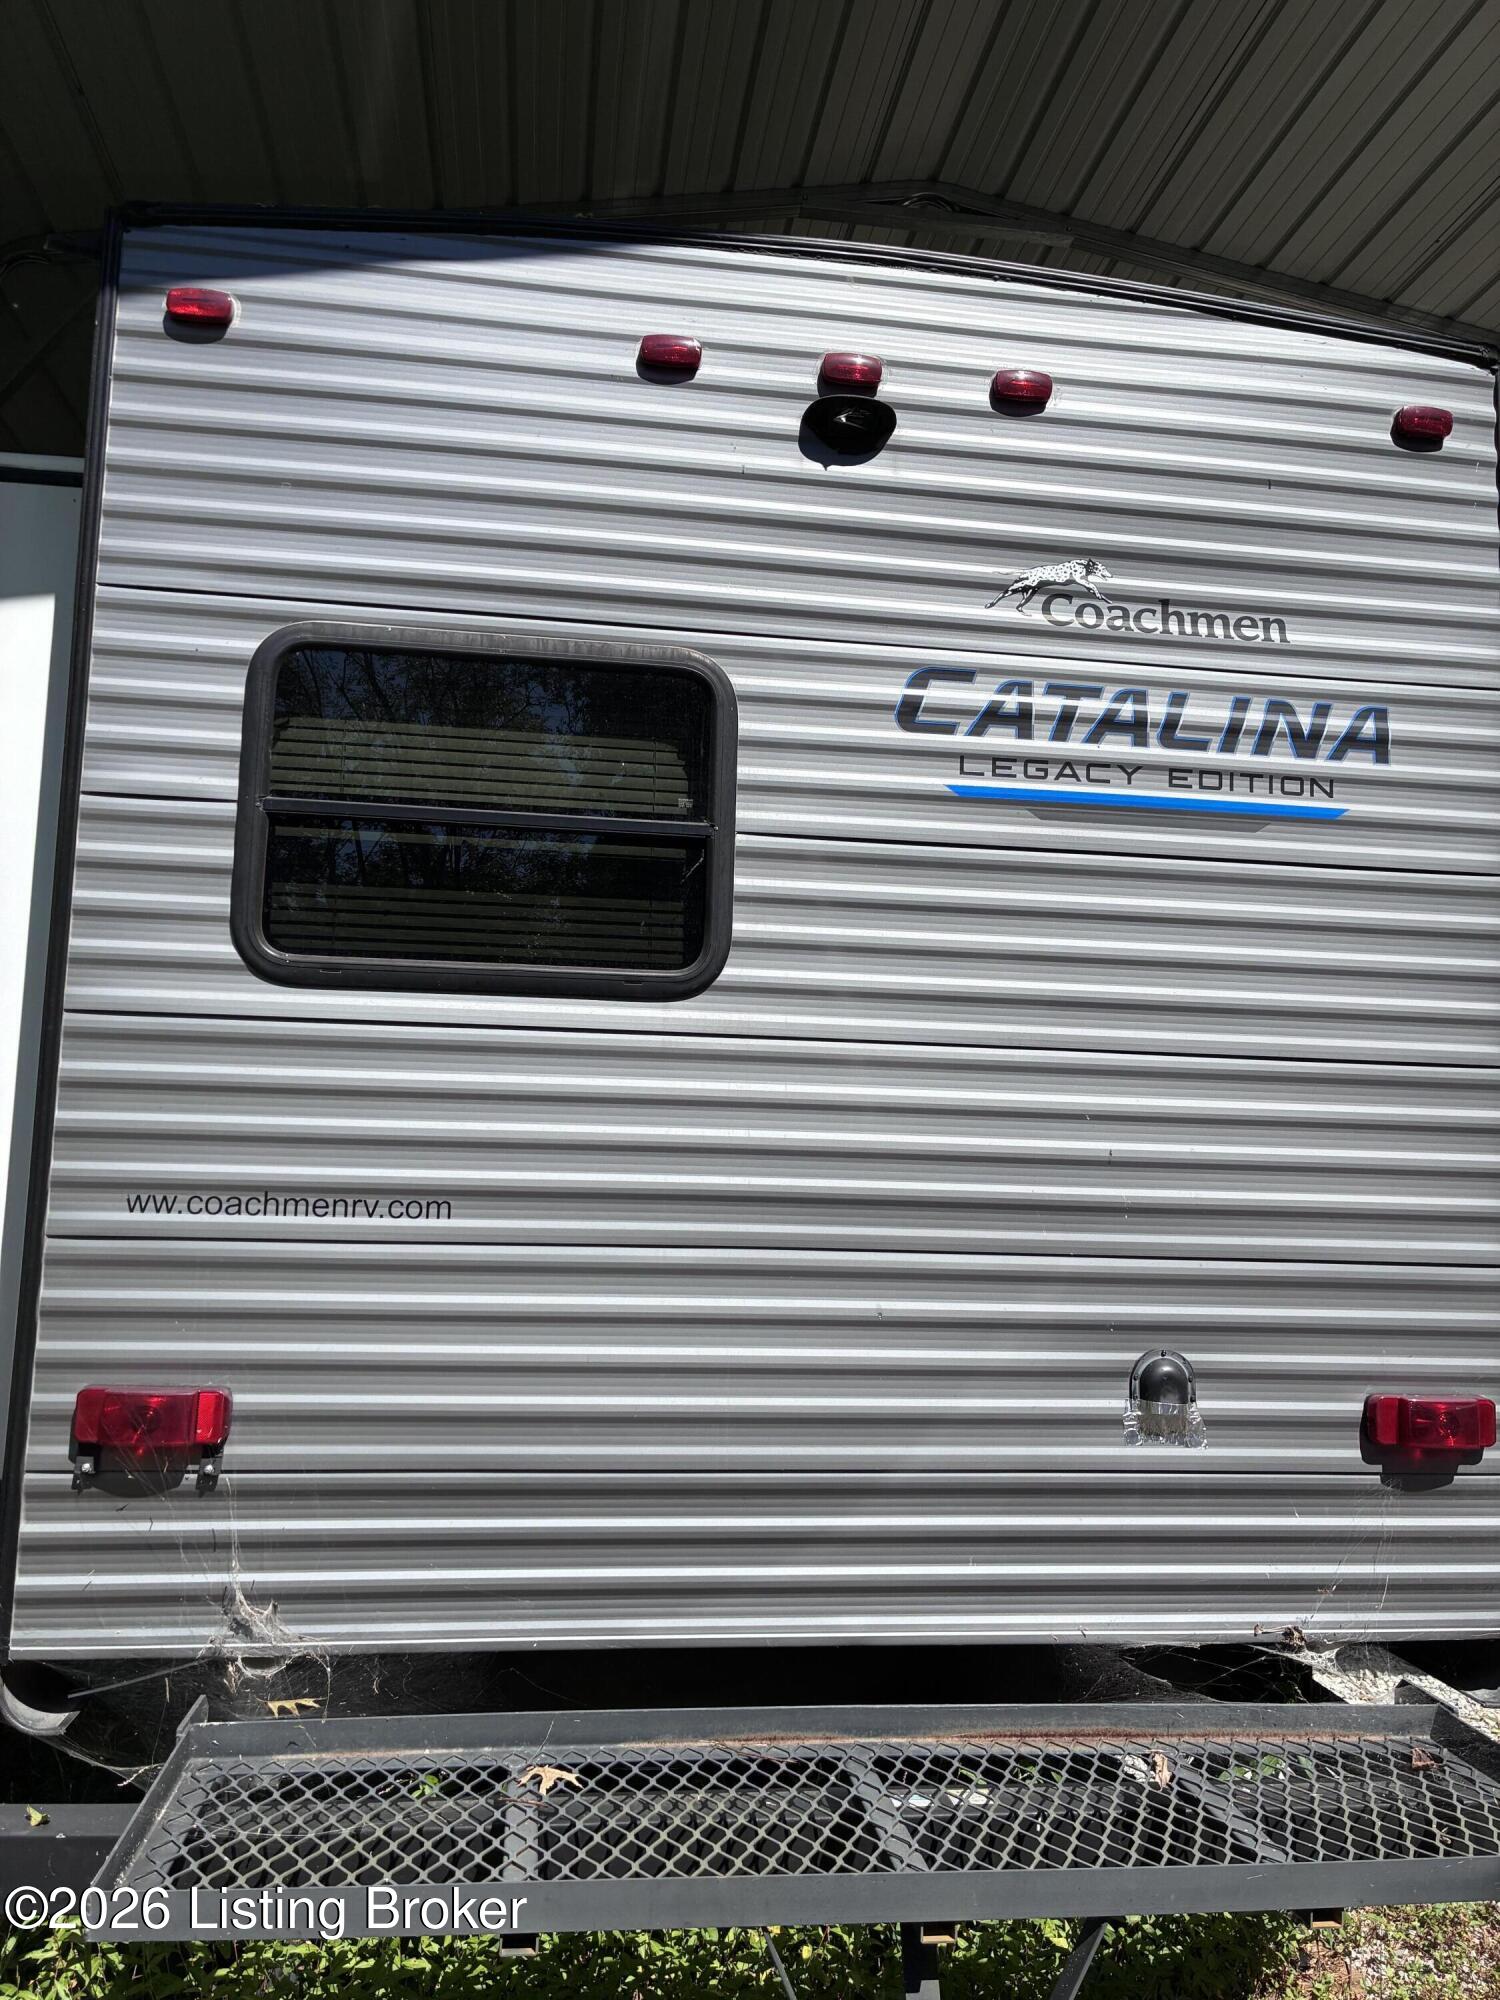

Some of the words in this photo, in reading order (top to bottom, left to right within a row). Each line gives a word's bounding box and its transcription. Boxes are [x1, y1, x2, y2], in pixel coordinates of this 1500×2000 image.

[1041, 593, 1290, 643] Coachmen
[894, 666, 1392, 766] CATALINA
[959, 755, 1144, 785] LEGACY
[1168, 768, 1335, 798] EDITION
[126, 1191, 452, 1220] ww.coachmenrv.com
